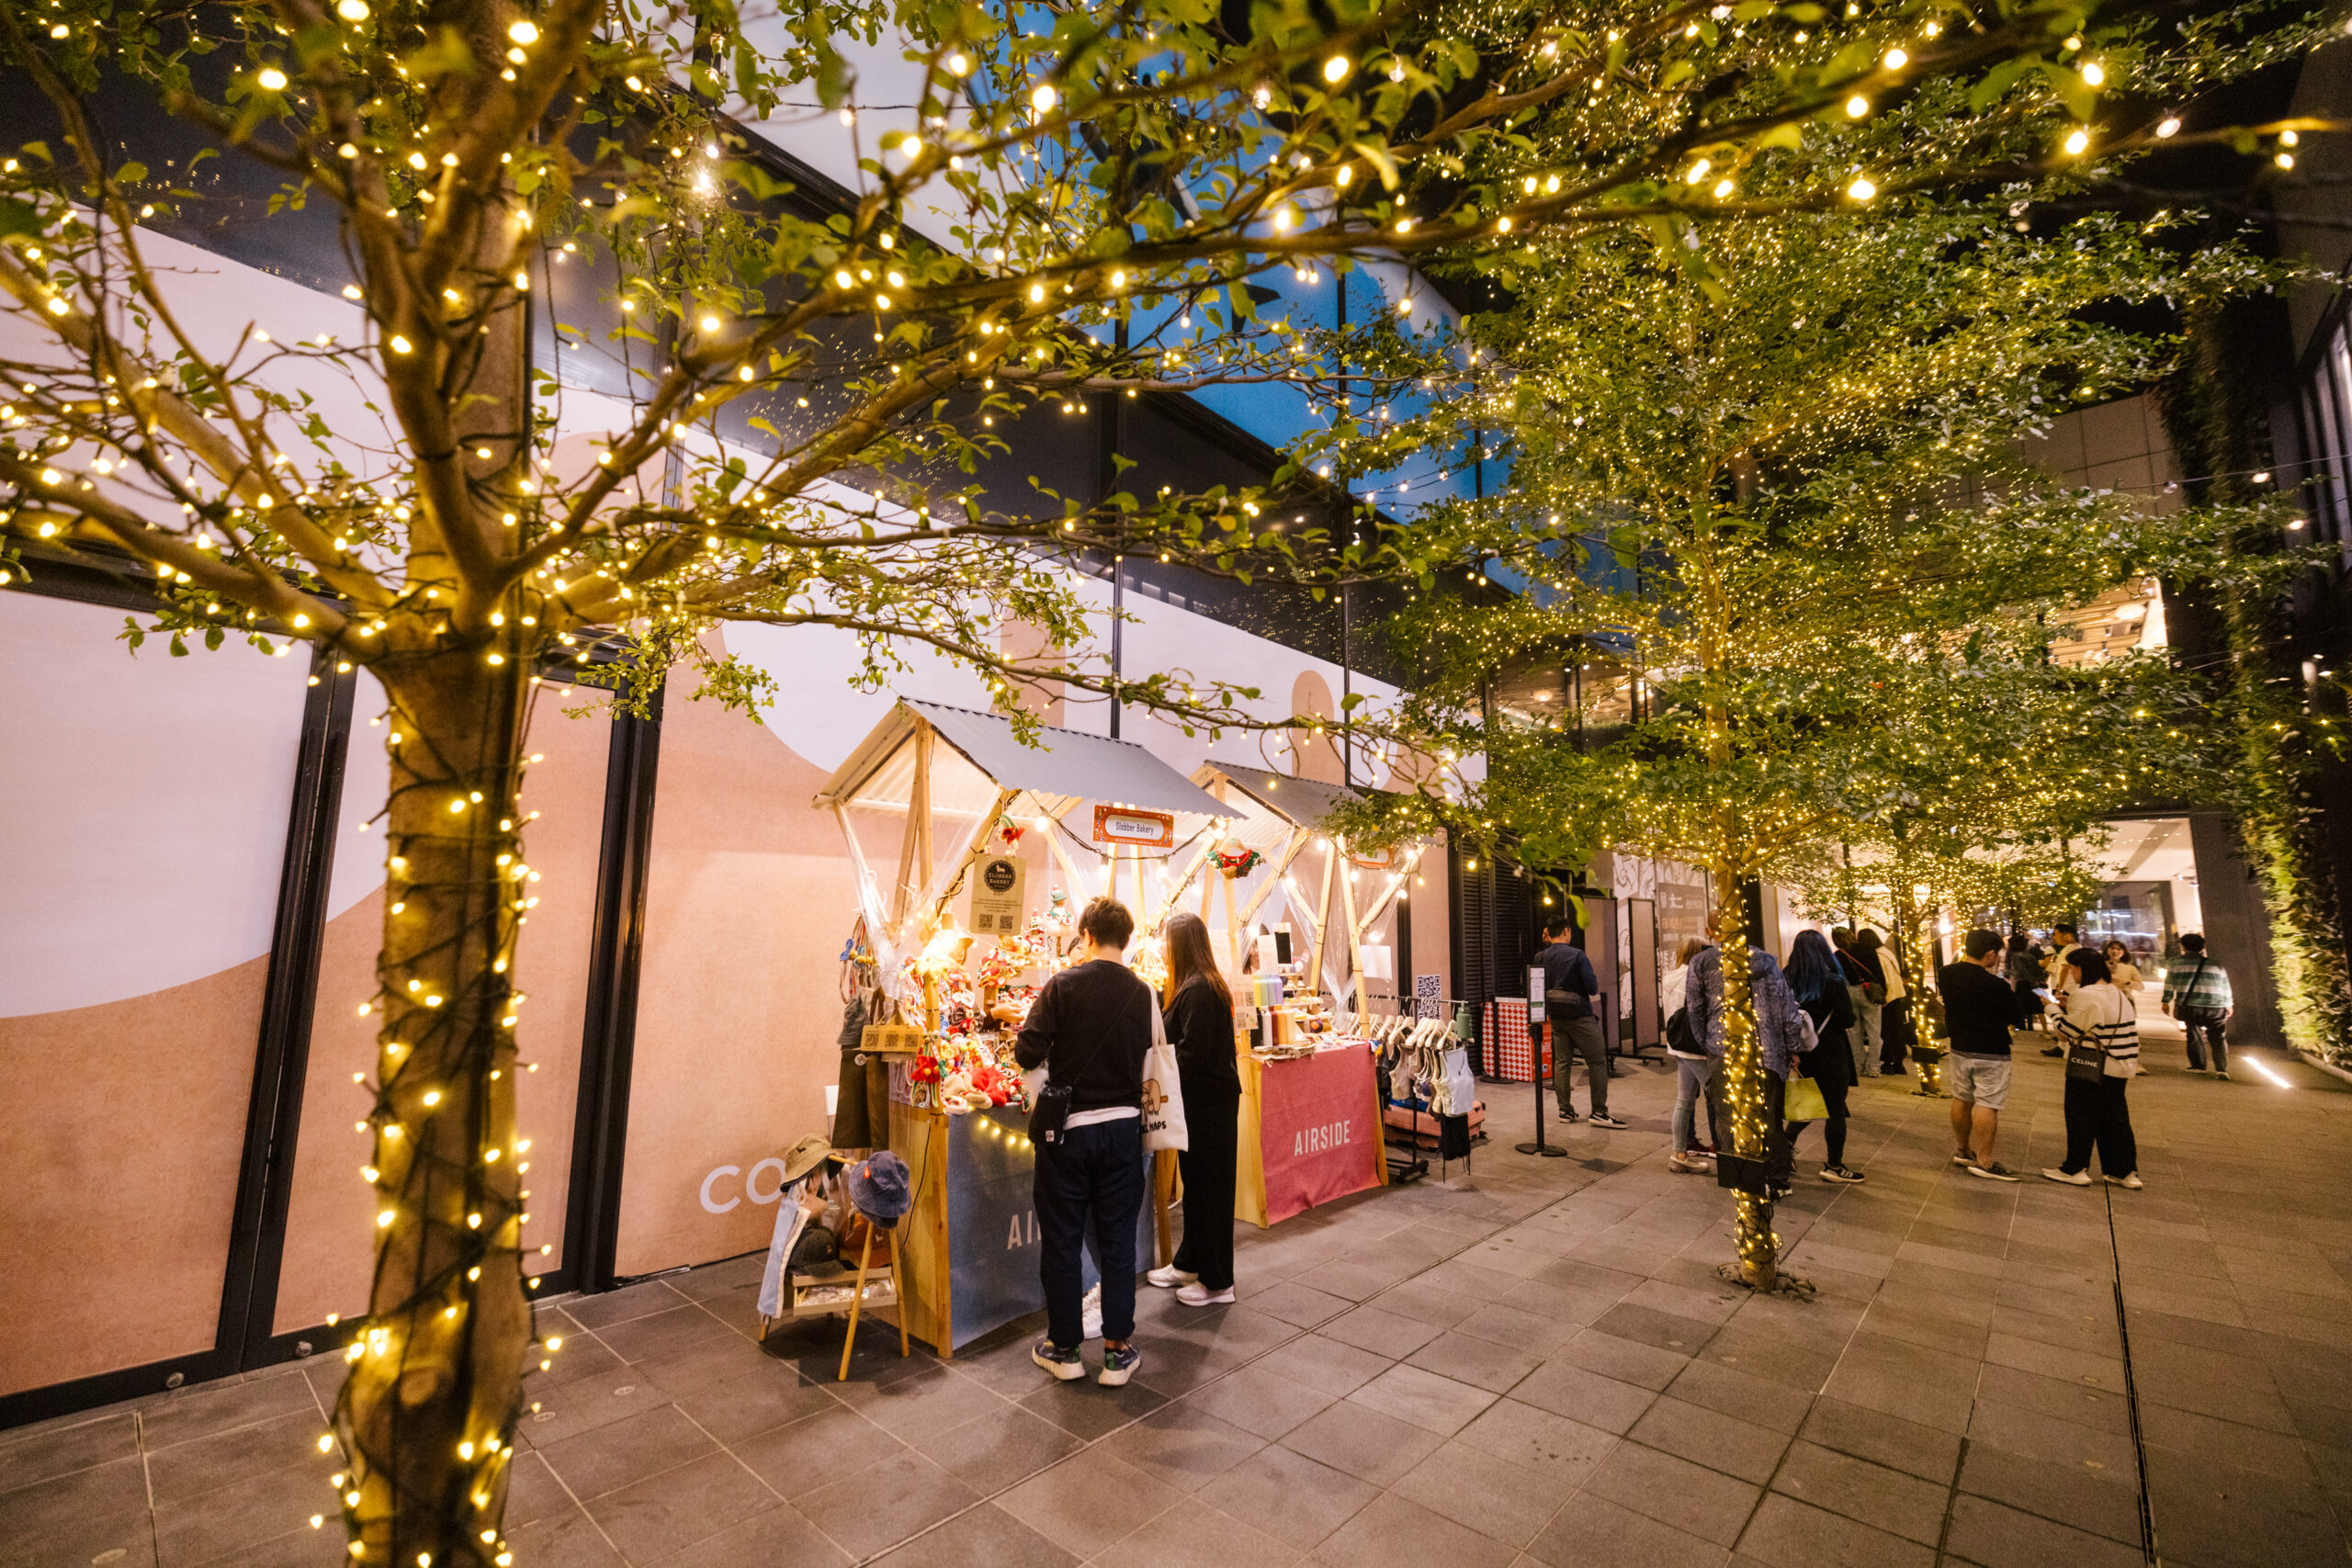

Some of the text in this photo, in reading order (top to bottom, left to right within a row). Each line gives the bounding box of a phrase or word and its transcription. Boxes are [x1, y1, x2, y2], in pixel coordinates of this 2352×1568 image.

[1115, 821, 1155, 836] Slobber Bakery
[2071, 1057, 2098, 1067] CELINE
[1149, 1121, 1167, 1132] NAPS
[1294, 1119, 1351, 1156] AIRSIDE
[1007, 1209, 1042, 1250] AI
